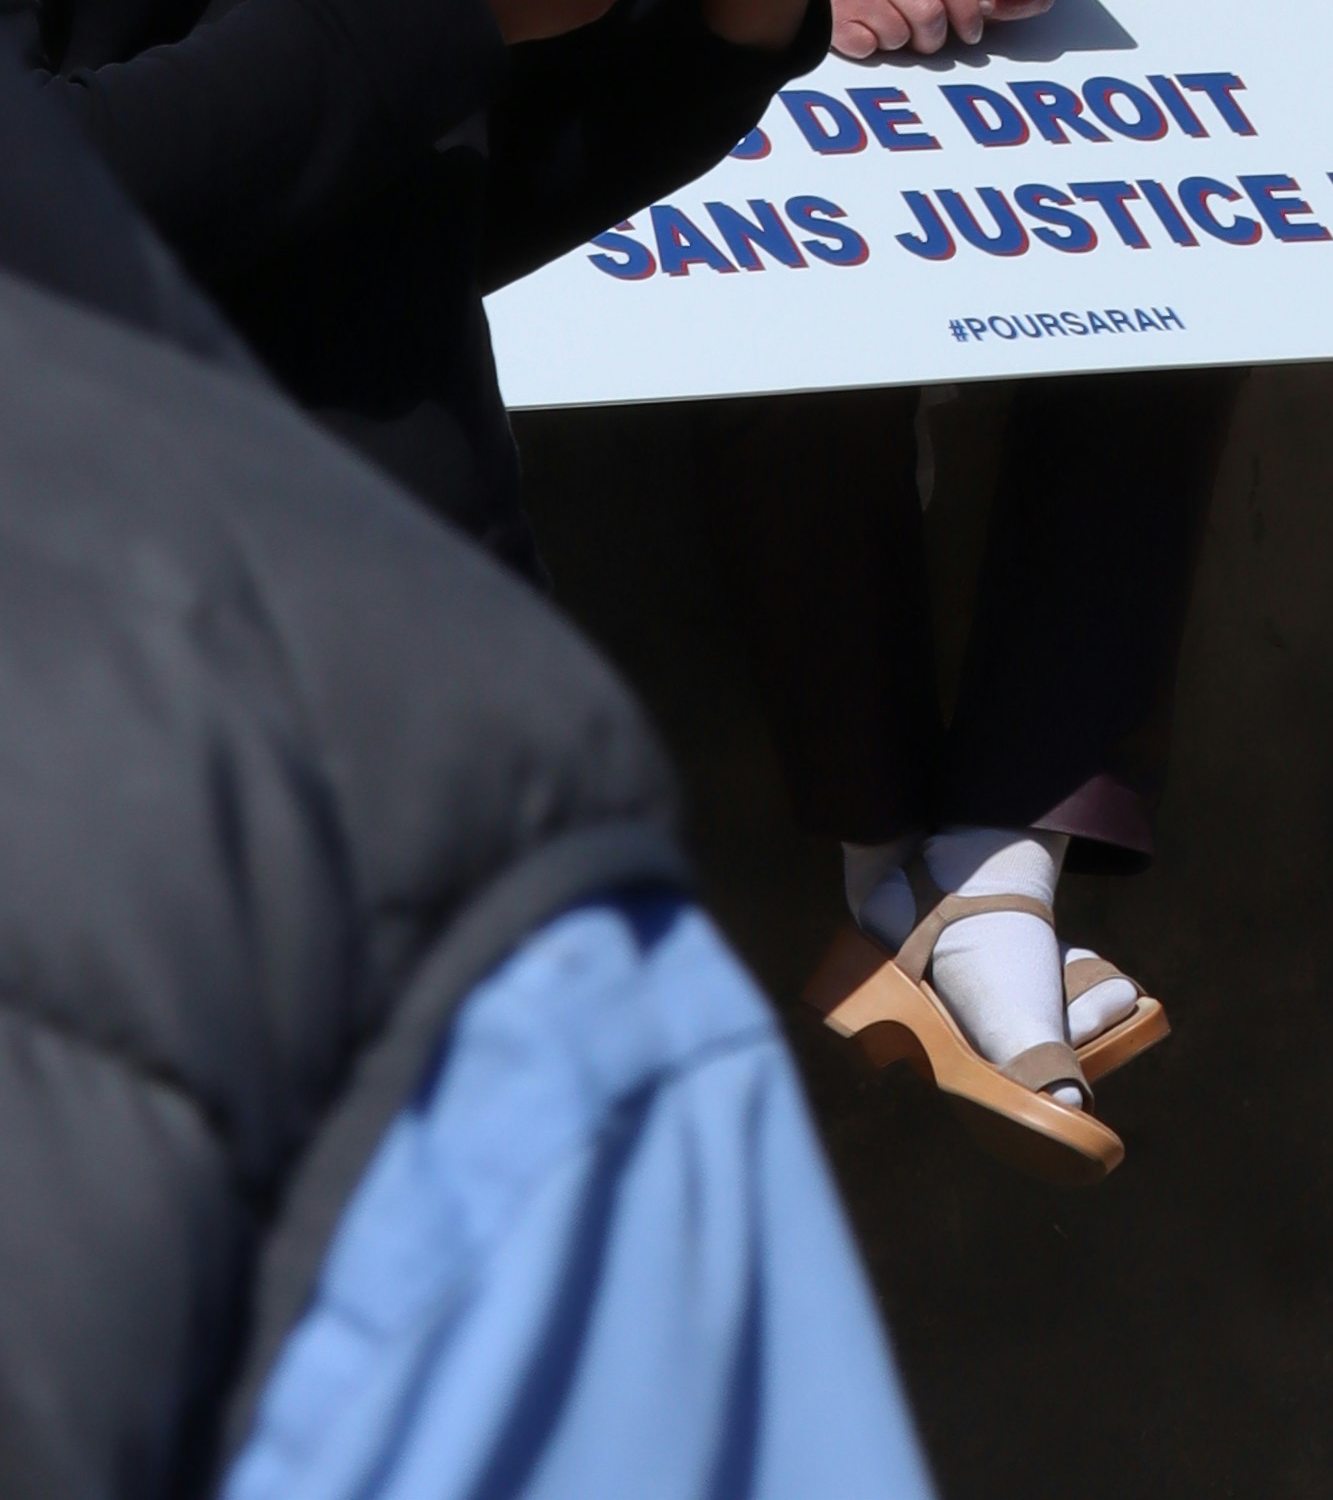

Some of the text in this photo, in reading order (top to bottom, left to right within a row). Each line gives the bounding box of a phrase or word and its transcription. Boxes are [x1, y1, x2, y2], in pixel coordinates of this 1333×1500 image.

[778, 86, 942, 155] DE
[938, 72, 1258, 148] DROIT
[587, 195, 869, 281] SANS
[896, 173, 1333, 261] JUSTICE
[949, 306, 1186, 343] #POURSARAH
